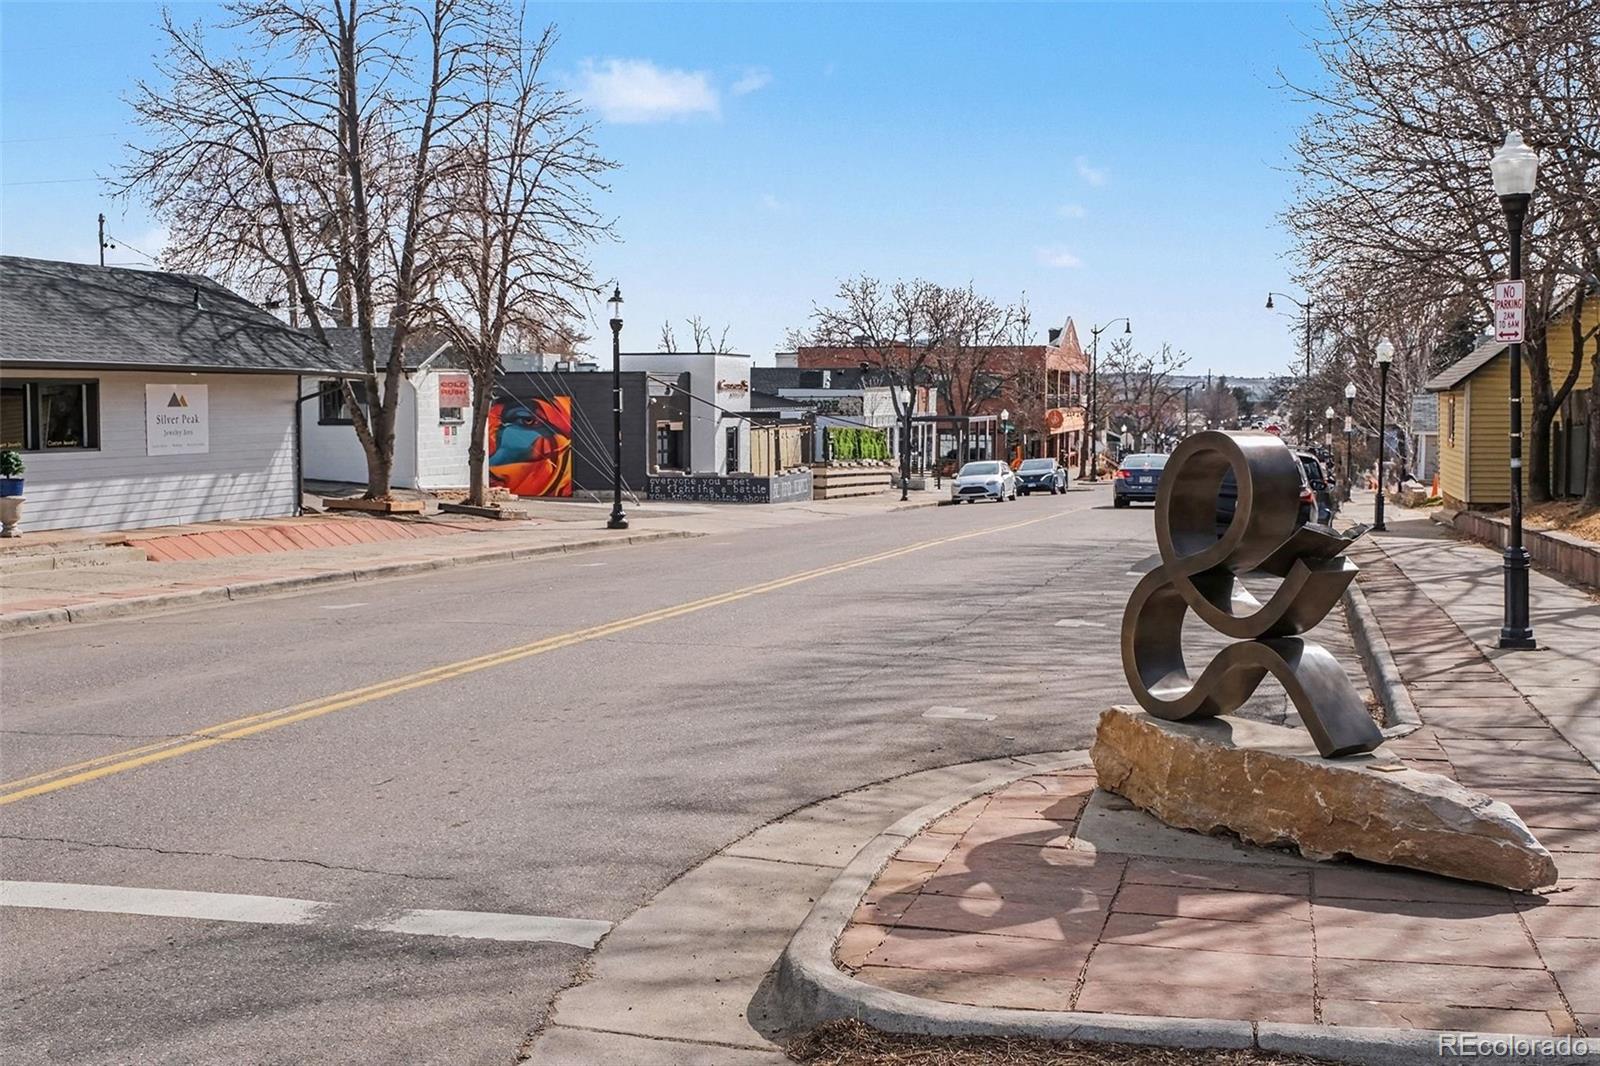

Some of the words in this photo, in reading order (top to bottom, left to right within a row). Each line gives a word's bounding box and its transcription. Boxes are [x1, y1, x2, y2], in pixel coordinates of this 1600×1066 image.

[1503, 286, 1515, 298] NO
[1496, 299, 1522, 309] PARKING
[1503, 311, 1515, 320] 2AM
[1499, 320, 1506, 329] TO
[156, 414, 179, 425] Silver
[182, 414, 201, 424] Peak
[649, 479, 697, 487] everyone
[702, 479, 721, 487] you
[727, 478, 751, 486] meet
[650, 485, 661, 493] is
[667, 485, 717, 495] fighting
[733, 485, 767, 494] battle
